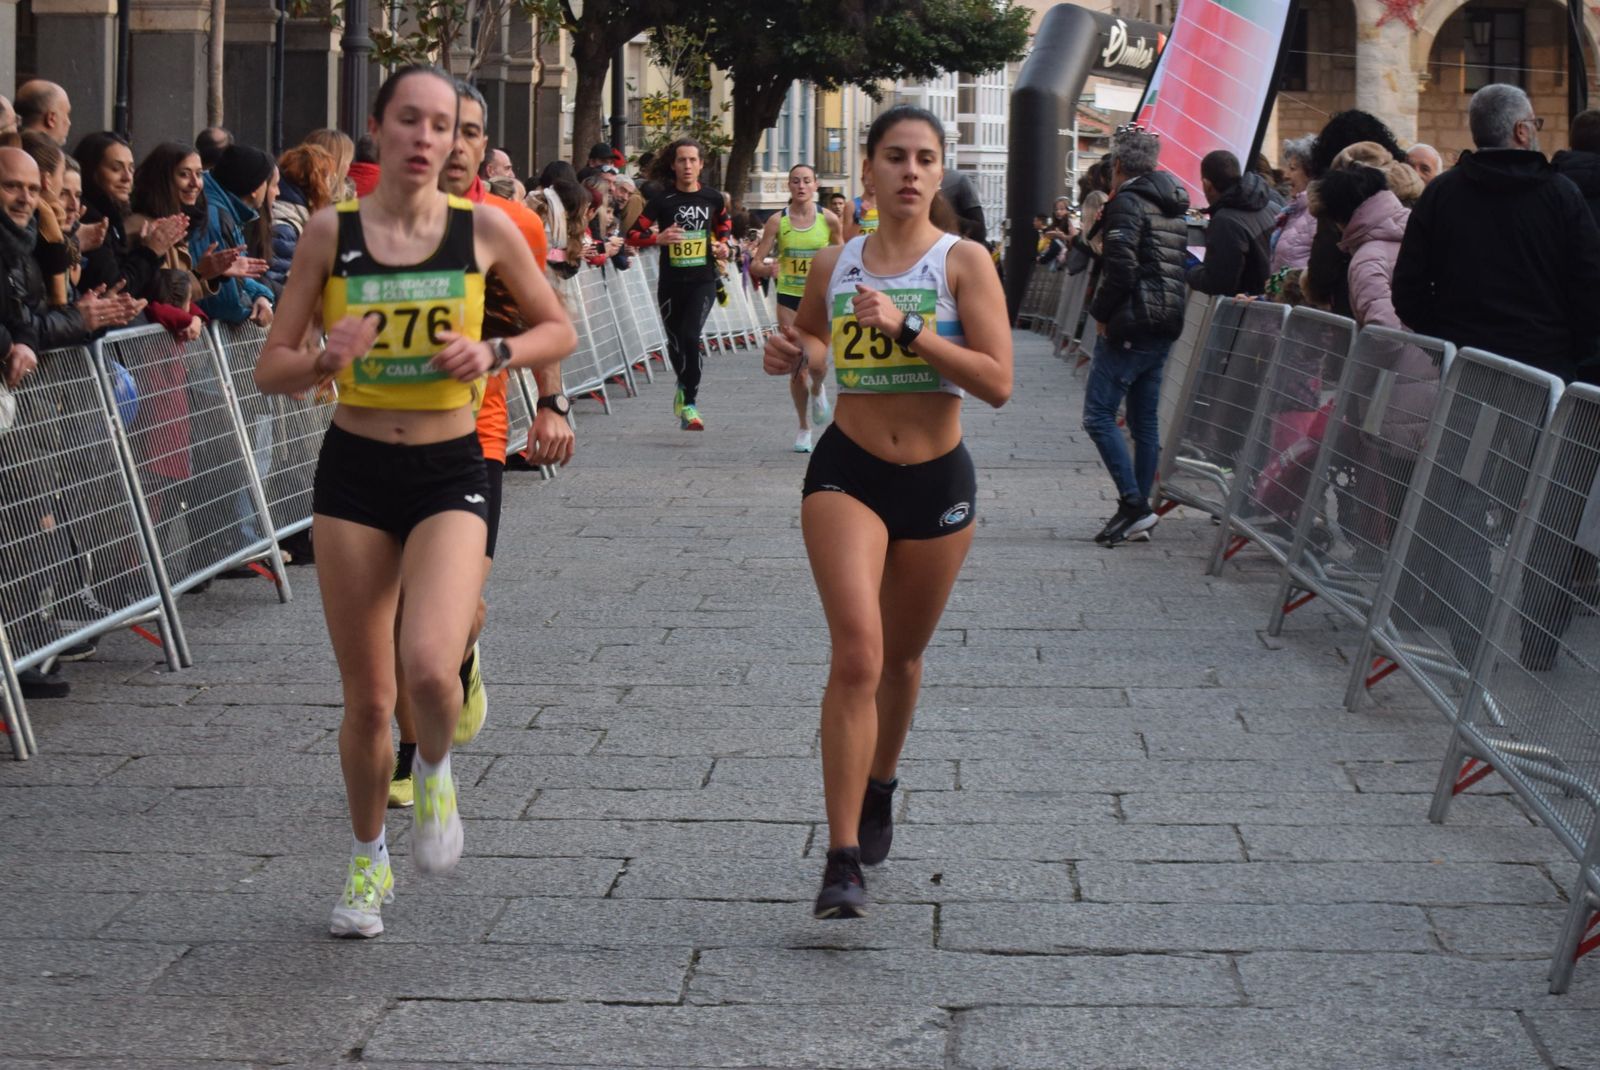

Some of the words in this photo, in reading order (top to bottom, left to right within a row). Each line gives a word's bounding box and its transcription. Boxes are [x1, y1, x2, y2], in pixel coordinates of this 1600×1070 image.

[674, 206, 709, 222] SAN
[673, 241, 703, 256] 687
[790, 259, 812, 274] 14
[363, 306, 452, 350] 276
[386, 364, 417, 376] CAJA
[860, 374, 890, 386] CAJA
[892, 372, 933, 384] RURAL
